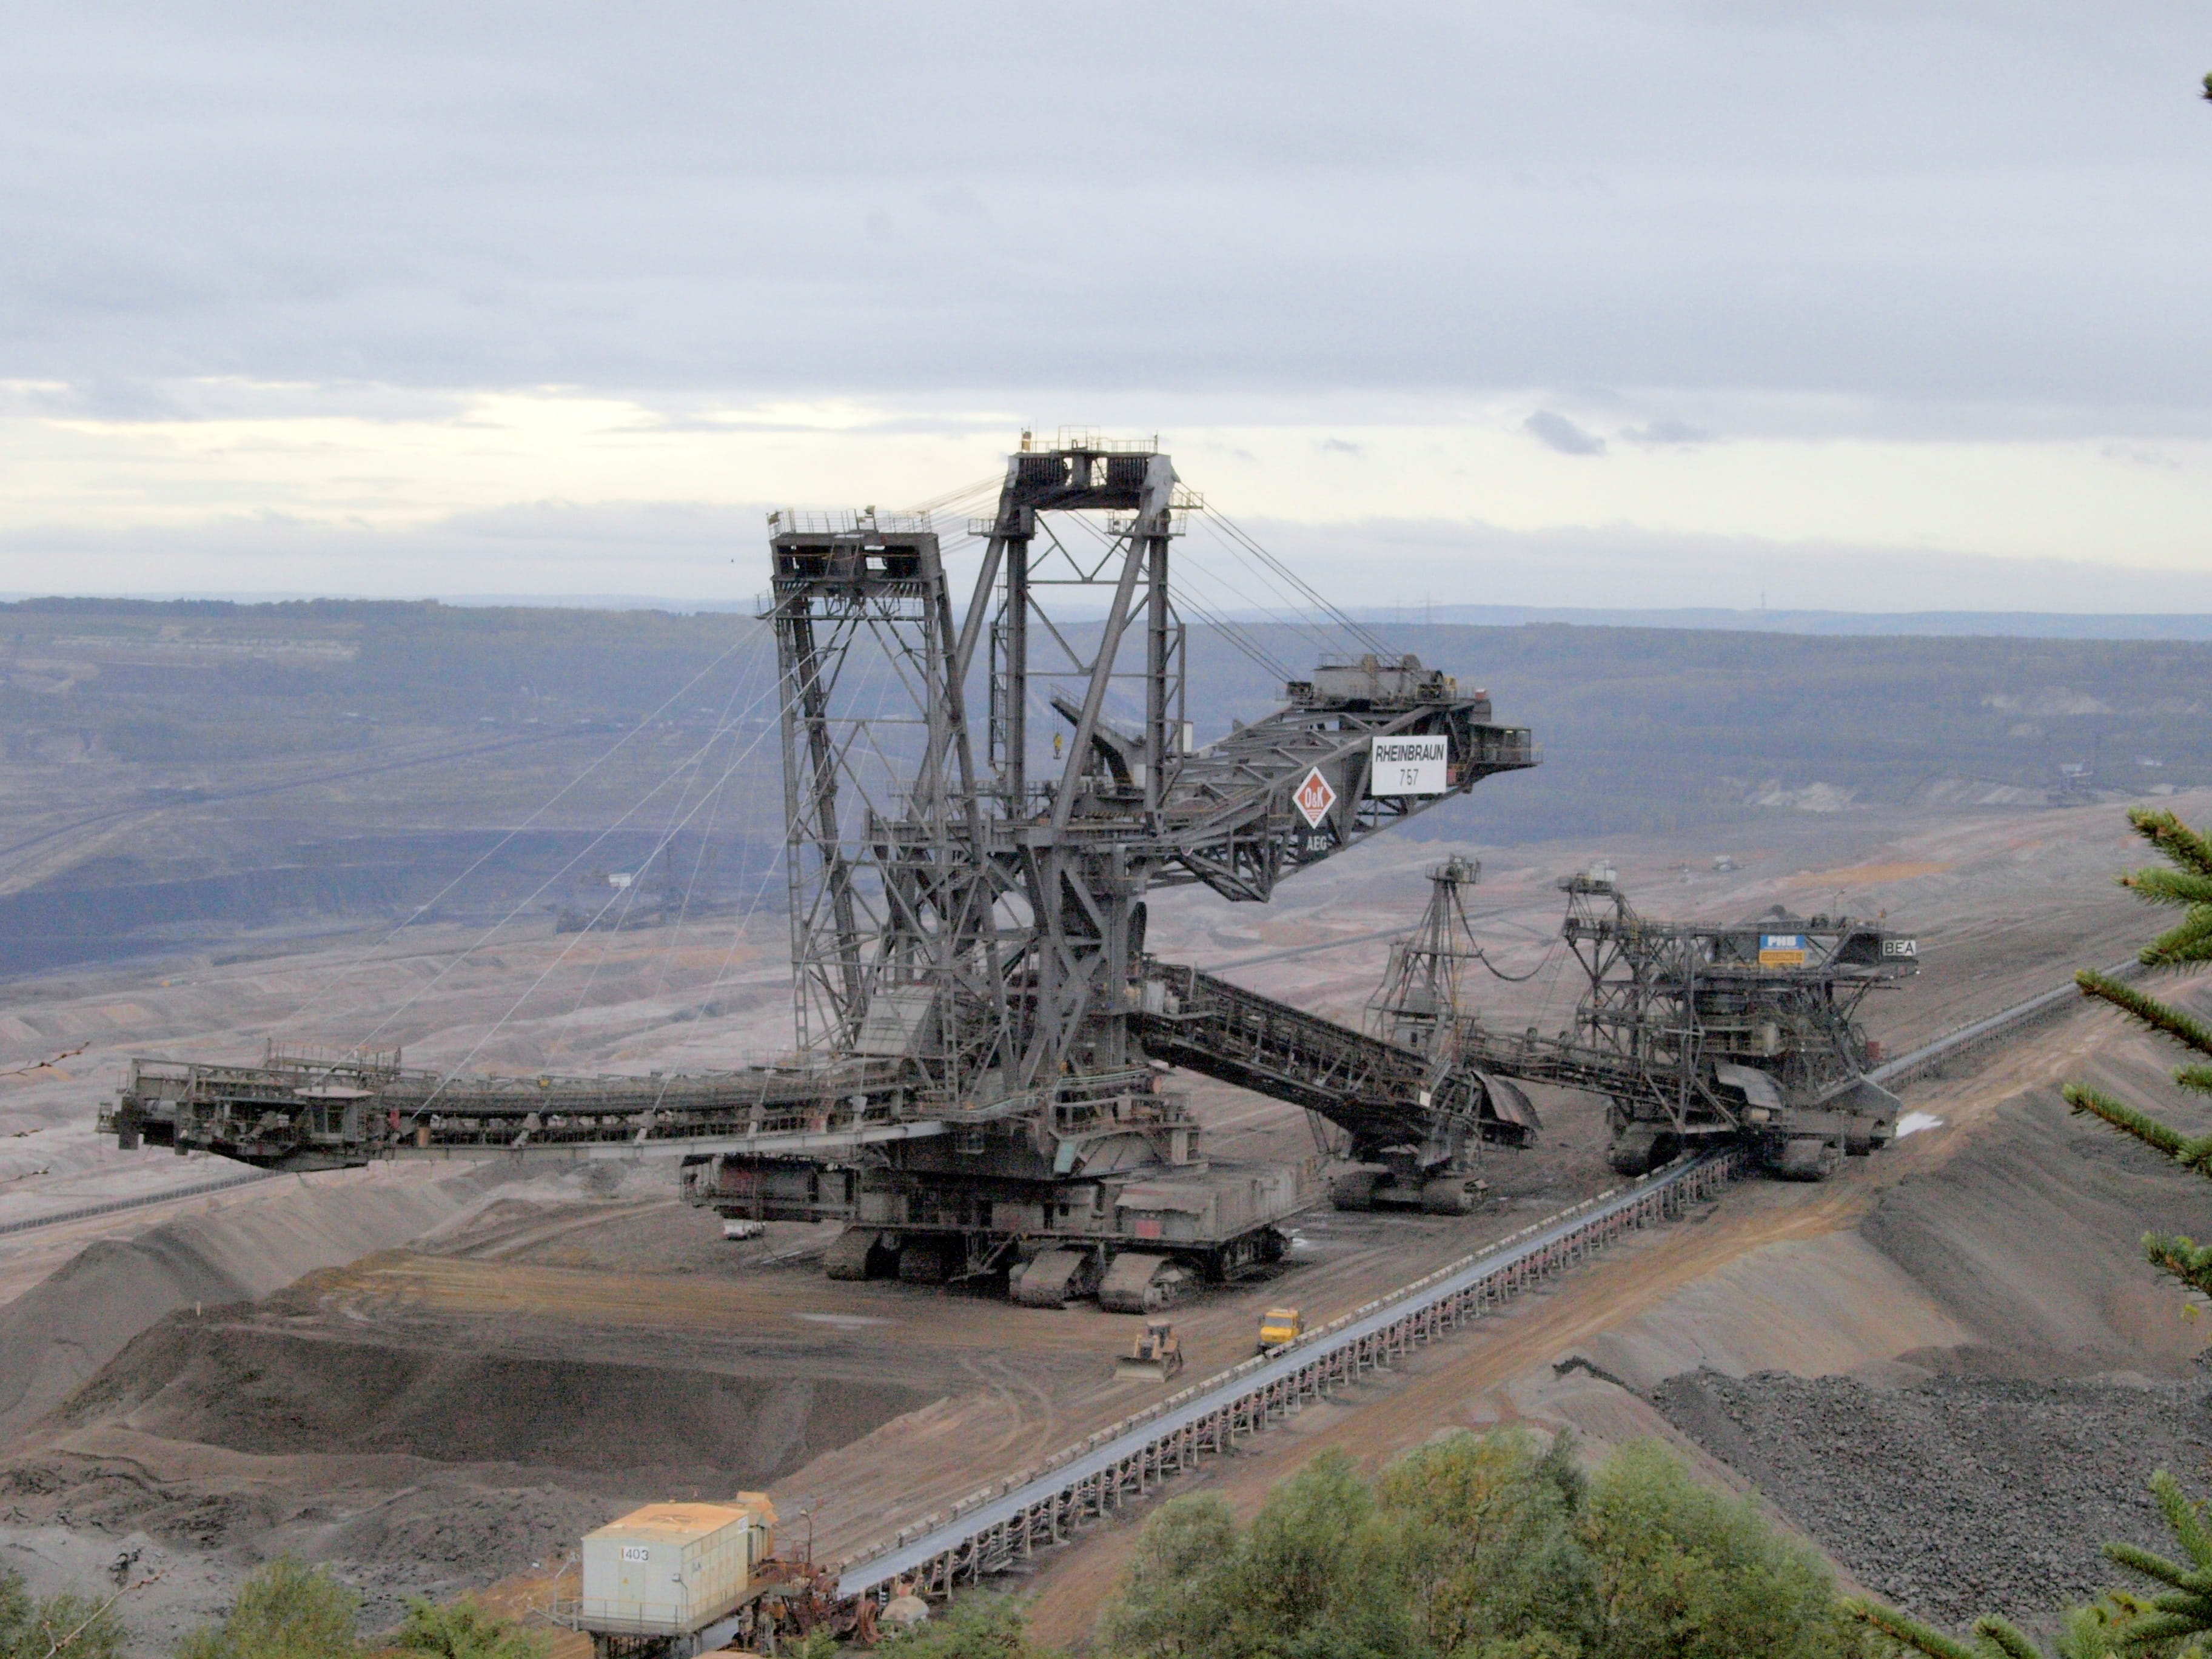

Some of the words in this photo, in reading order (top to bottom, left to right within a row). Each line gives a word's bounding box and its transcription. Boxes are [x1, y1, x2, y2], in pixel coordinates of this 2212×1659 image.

[1375, 744, 1444, 762] RHEINBRAUN
[1399, 768, 1419, 786] 757
[1304, 786, 1324, 808] O&K
[1306, 835, 1327, 851] AEG
[1885, 942, 1914, 954] BEA
